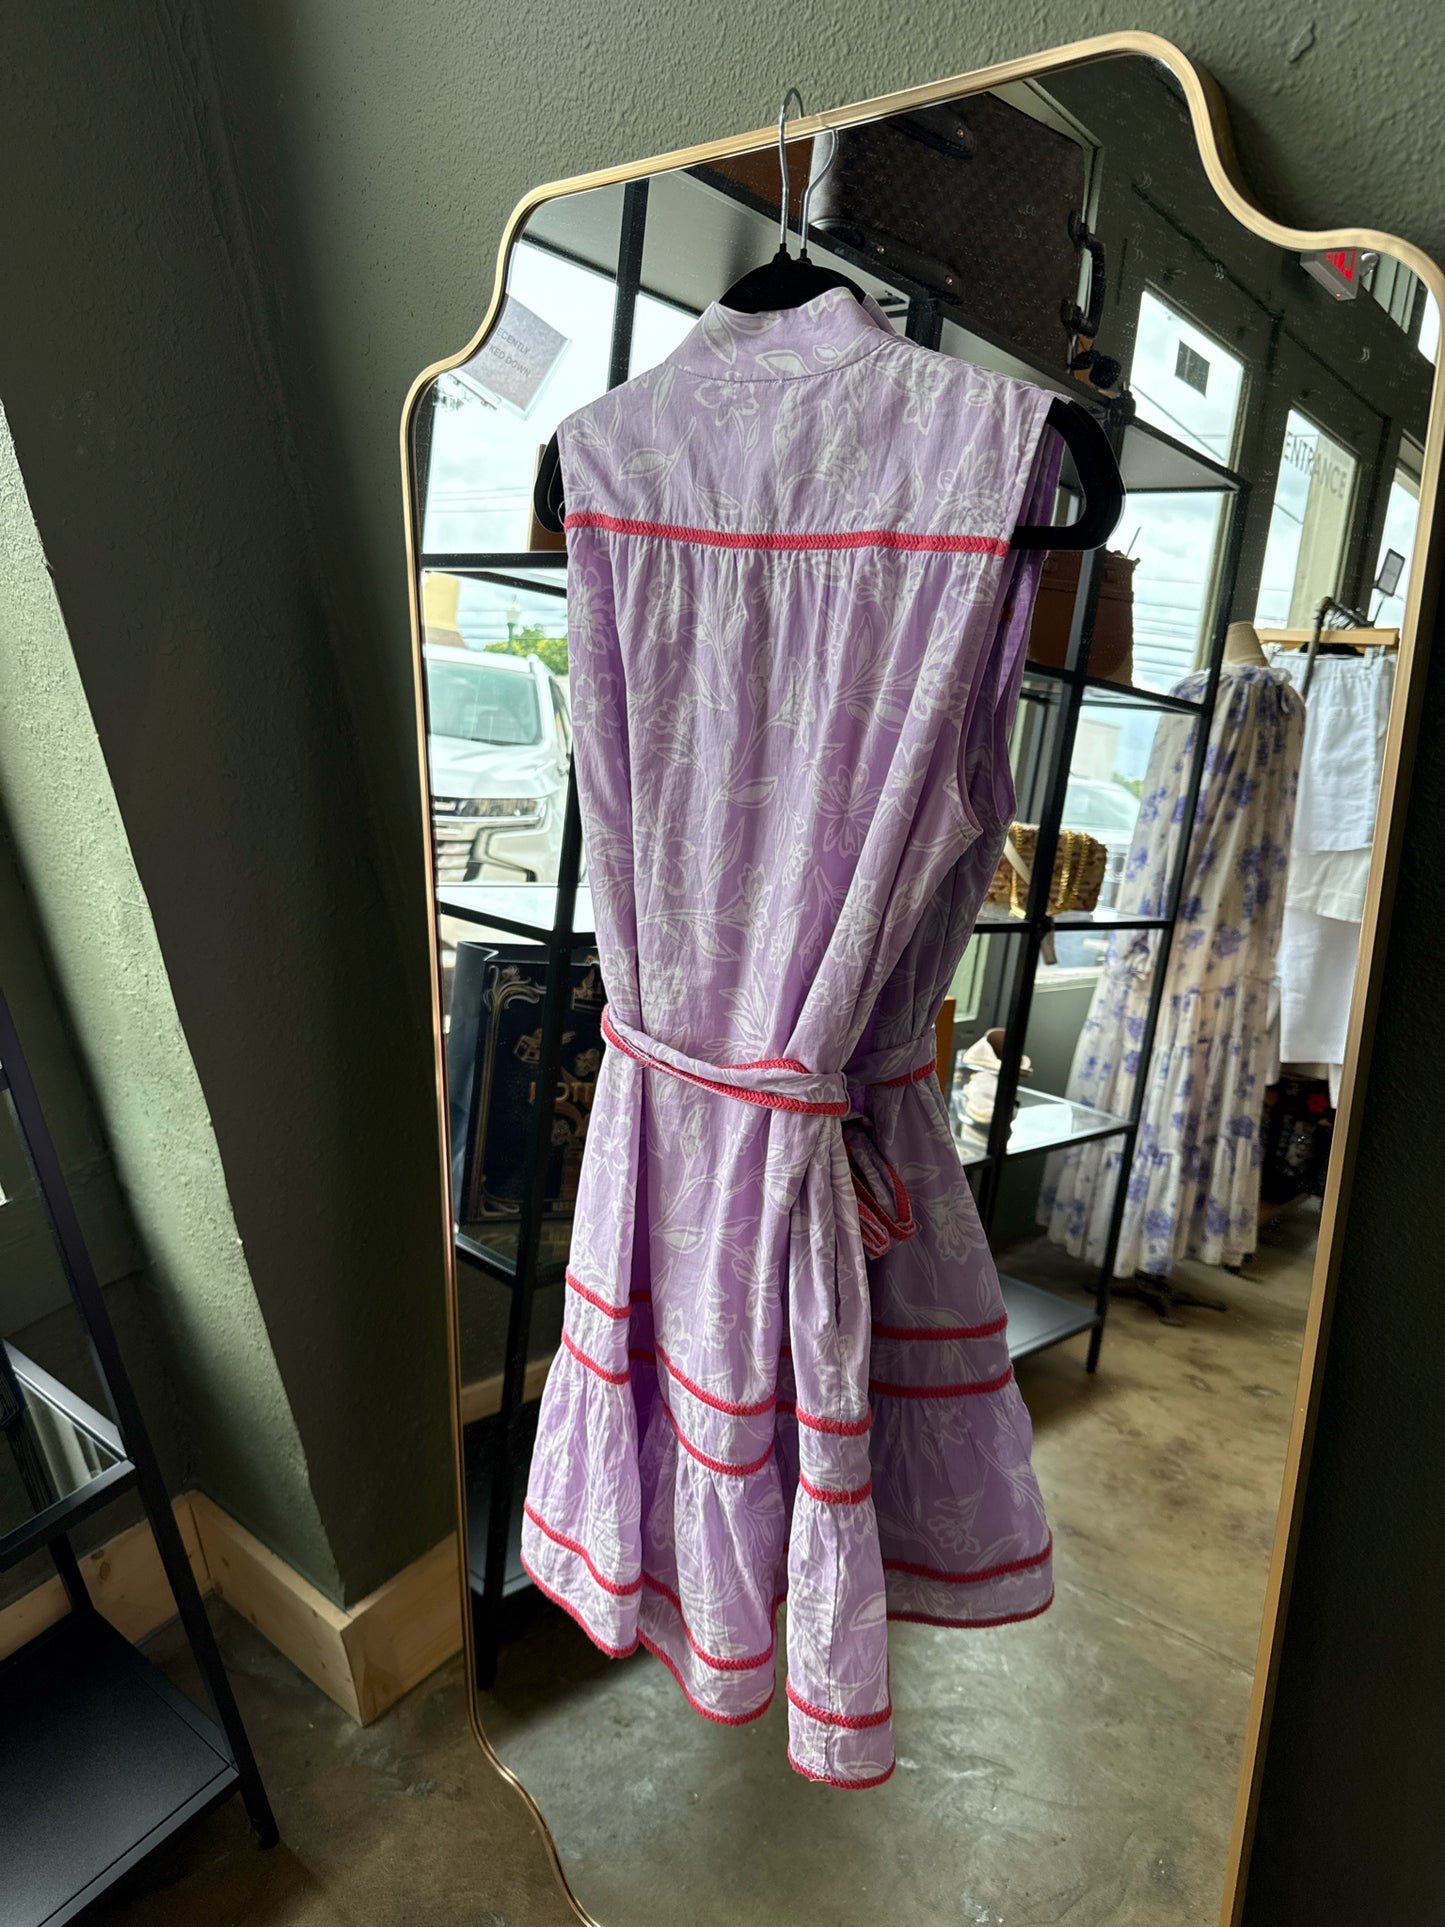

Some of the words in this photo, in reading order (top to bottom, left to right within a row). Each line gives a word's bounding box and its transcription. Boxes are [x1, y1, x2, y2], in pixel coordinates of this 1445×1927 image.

[496, 327, 531, 355] ECENTLY
[488, 343, 505, 360] KED
[505, 356, 532, 377] DOWN
[1284, 431, 1347, 500] ENTRANCE
